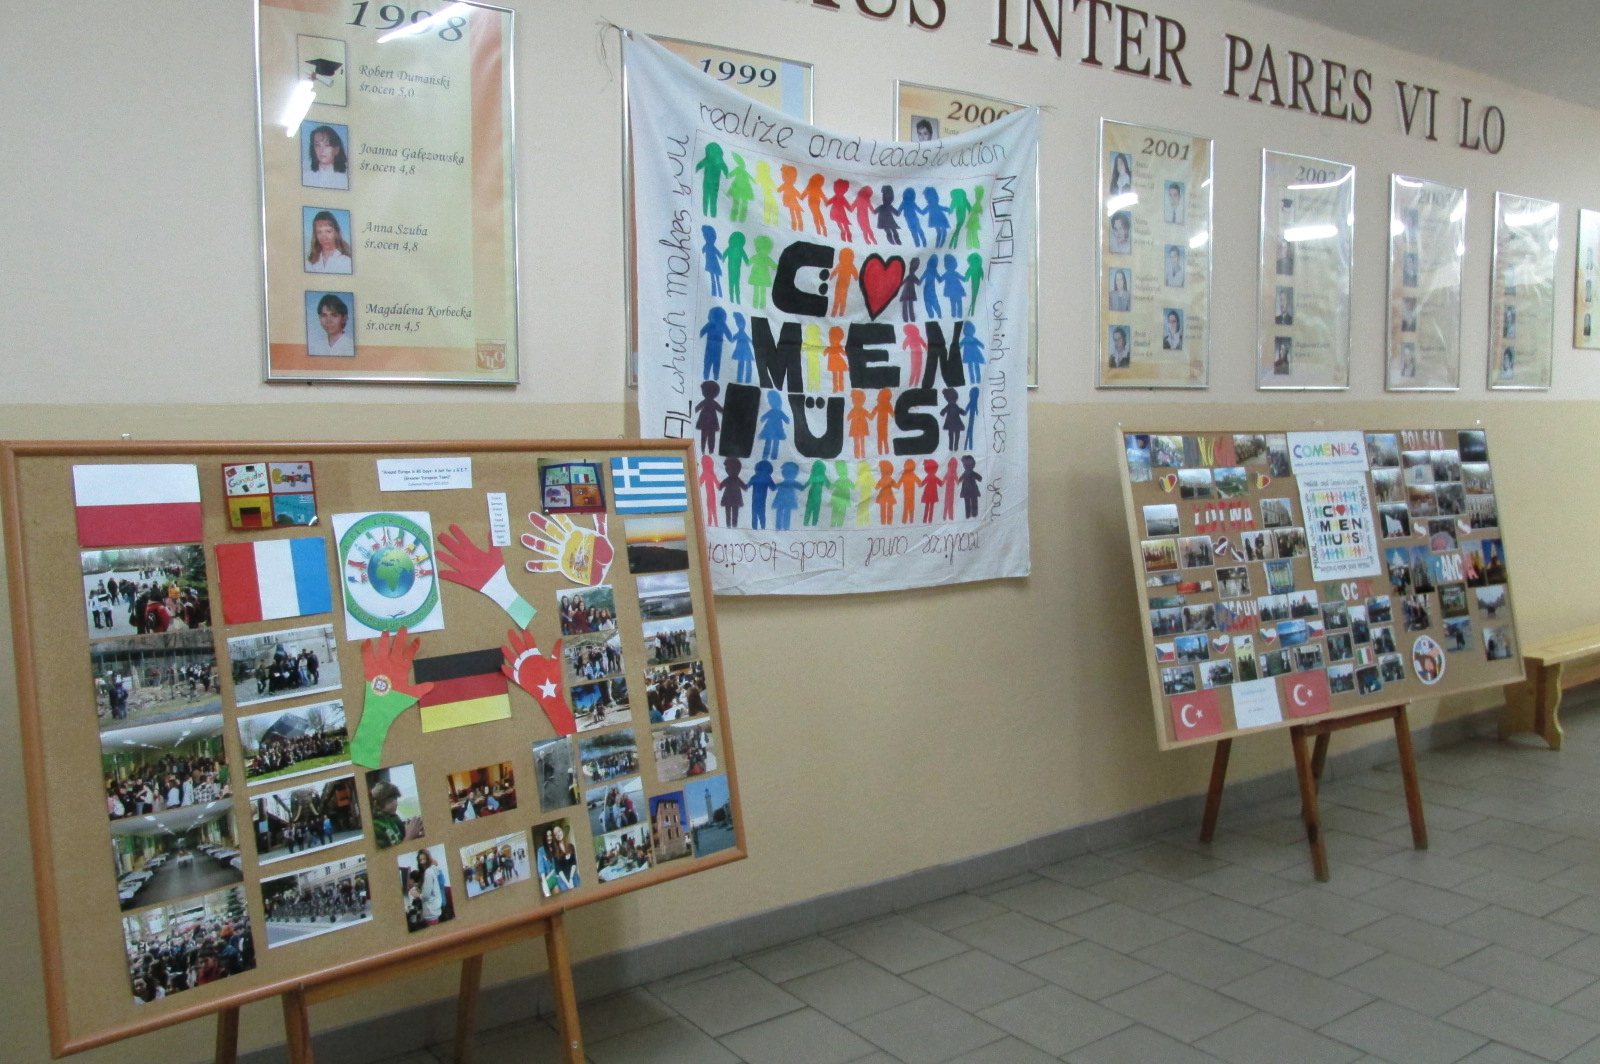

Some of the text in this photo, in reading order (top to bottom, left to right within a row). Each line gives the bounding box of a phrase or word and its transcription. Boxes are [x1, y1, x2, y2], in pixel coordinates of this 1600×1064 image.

[360, 64, 394, 79] Robert
[701, 58, 777, 88] 1999
[990, 0, 1192, 86] INTER
[1223, 33, 1372, 124] PARES
[1395, 80, 1439, 141] VI
[1460, 97, 1506, 154] LO
[398, 86, 415, 98] 5,0
[700, 103, 793, 149] realize
[808, 133, 861, 162] and
[358, 143, 398, 157] Joanna
[1141, 138, 1191, 161] 2001
[399, 164, 416, 175] 4,8
[362, 221, 428, 236] Anna Szuba
[988, 175, 1017, 281] MURAL
[402, 243, 419, 253] 4,8
[659, 208, 692, 298] makes
[365, 303, 472, 320] Magdalena Korbecka
[404, 321, 420, 332] 4,5
[988, 370, 1011, 454] makes
[1293, 441, 1361, 459] COMENIUS
[789, 536, 845, 572] leads
[864, 535, 909, 567] and
